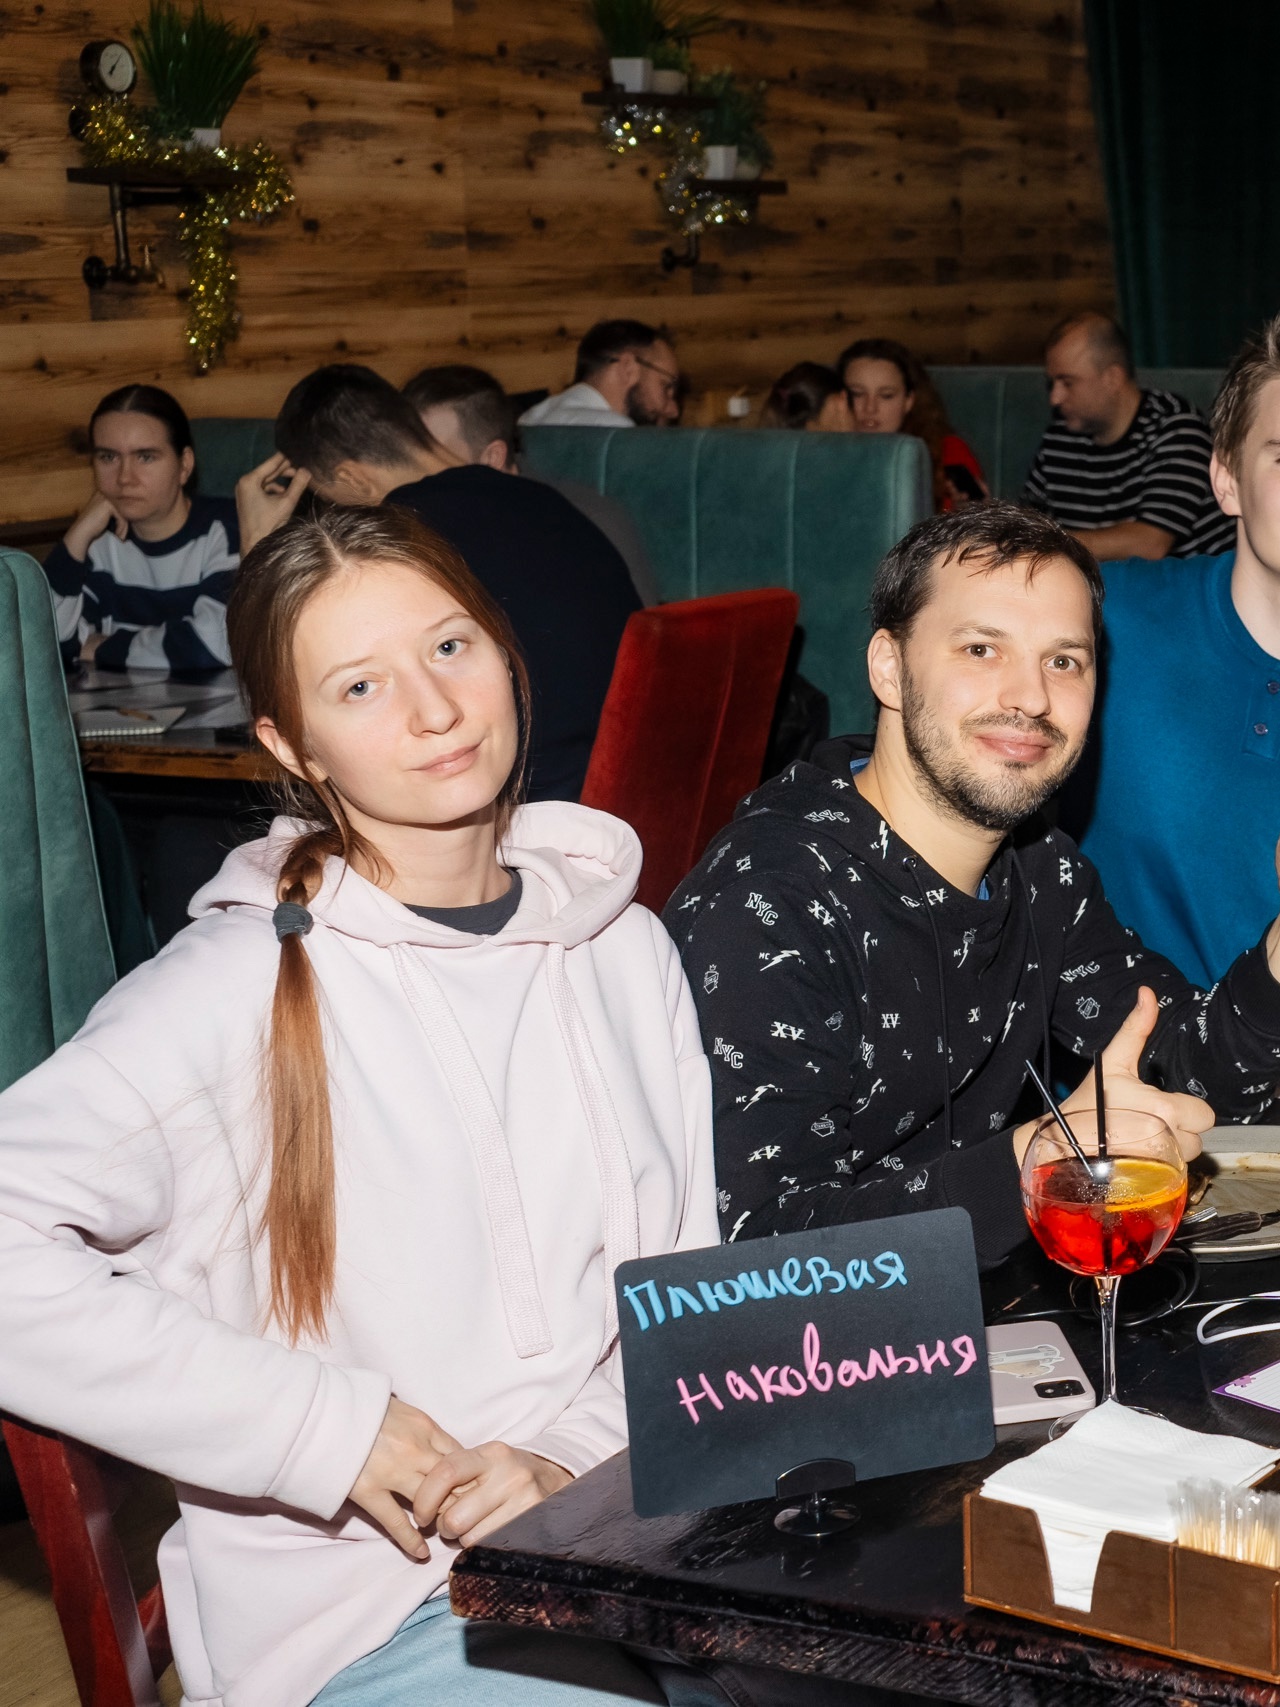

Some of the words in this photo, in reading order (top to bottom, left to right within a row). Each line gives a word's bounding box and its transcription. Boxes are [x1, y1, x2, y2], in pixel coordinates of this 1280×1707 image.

[804, 809, 850, 823] NYC
[745, 892, 778, 926] NYC
[807, 899, 837, 928] XV
[759, 952, 770, 961] MC
[1060, 961, 1100, 983] NYC
[770, 1021, 806, 1040] XV
[881, 1013, 901, 1028] XV
[713, 1037, 743, 1069] NYC
[748, 1145, 782, 1162] XV
[623, 1250, 908, 1331] Плюшевая
[676, 1321, 978, 1425] Наковальня
